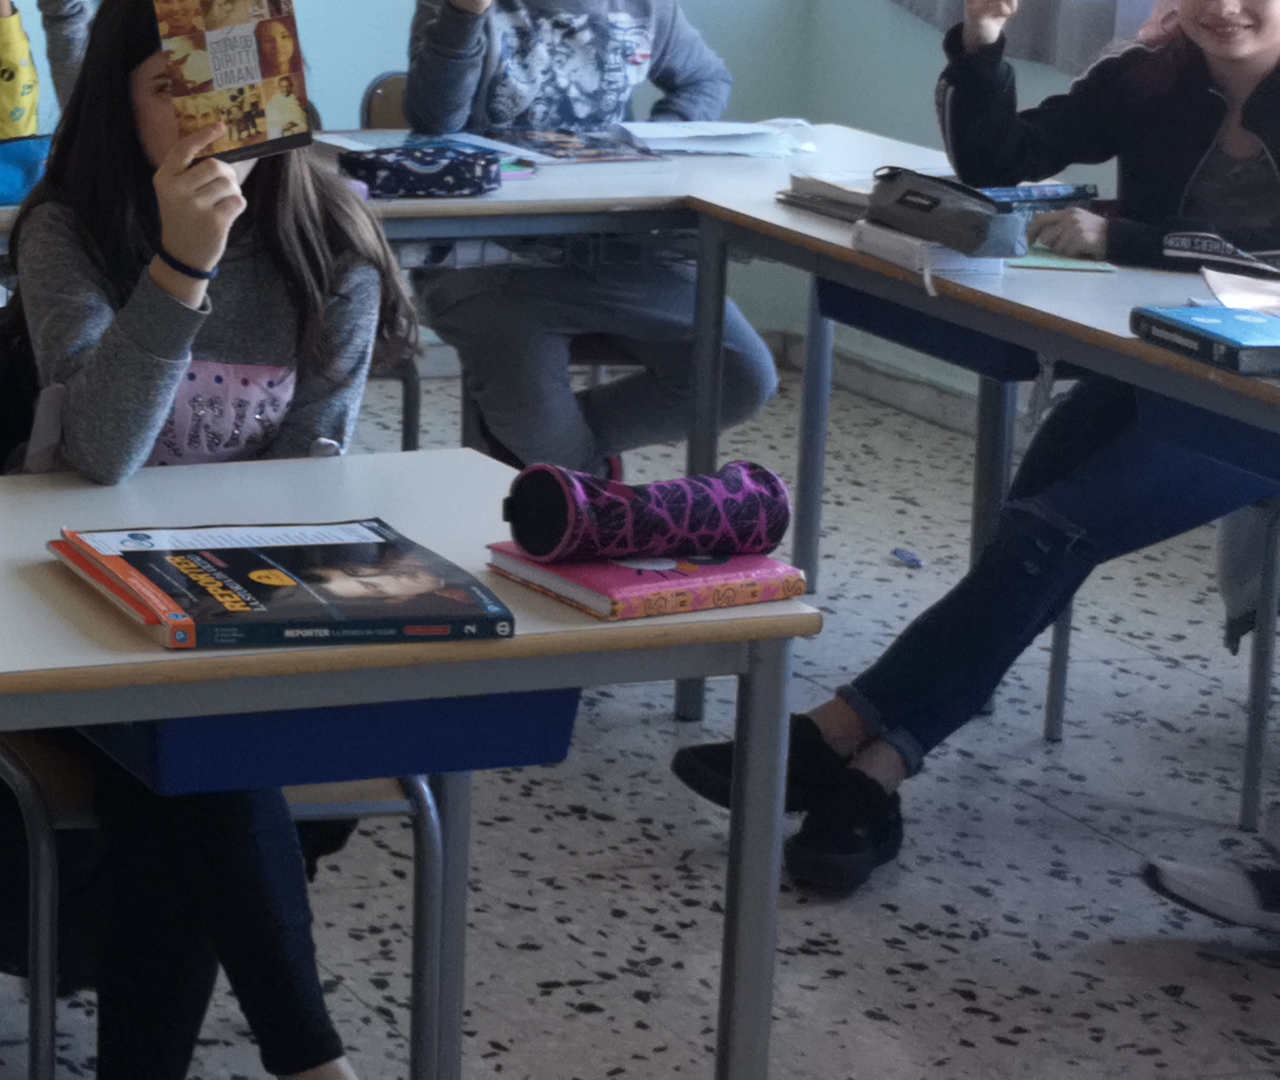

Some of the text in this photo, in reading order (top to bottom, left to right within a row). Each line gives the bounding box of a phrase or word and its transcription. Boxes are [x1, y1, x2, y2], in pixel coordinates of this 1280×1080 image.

[212, 49, 257, 71] DIRITTI
[215, 66, 259, 88] UMANI
[164, 556, 252, 612] REPORTER
[284, 628, 331, 638] REPORTER
